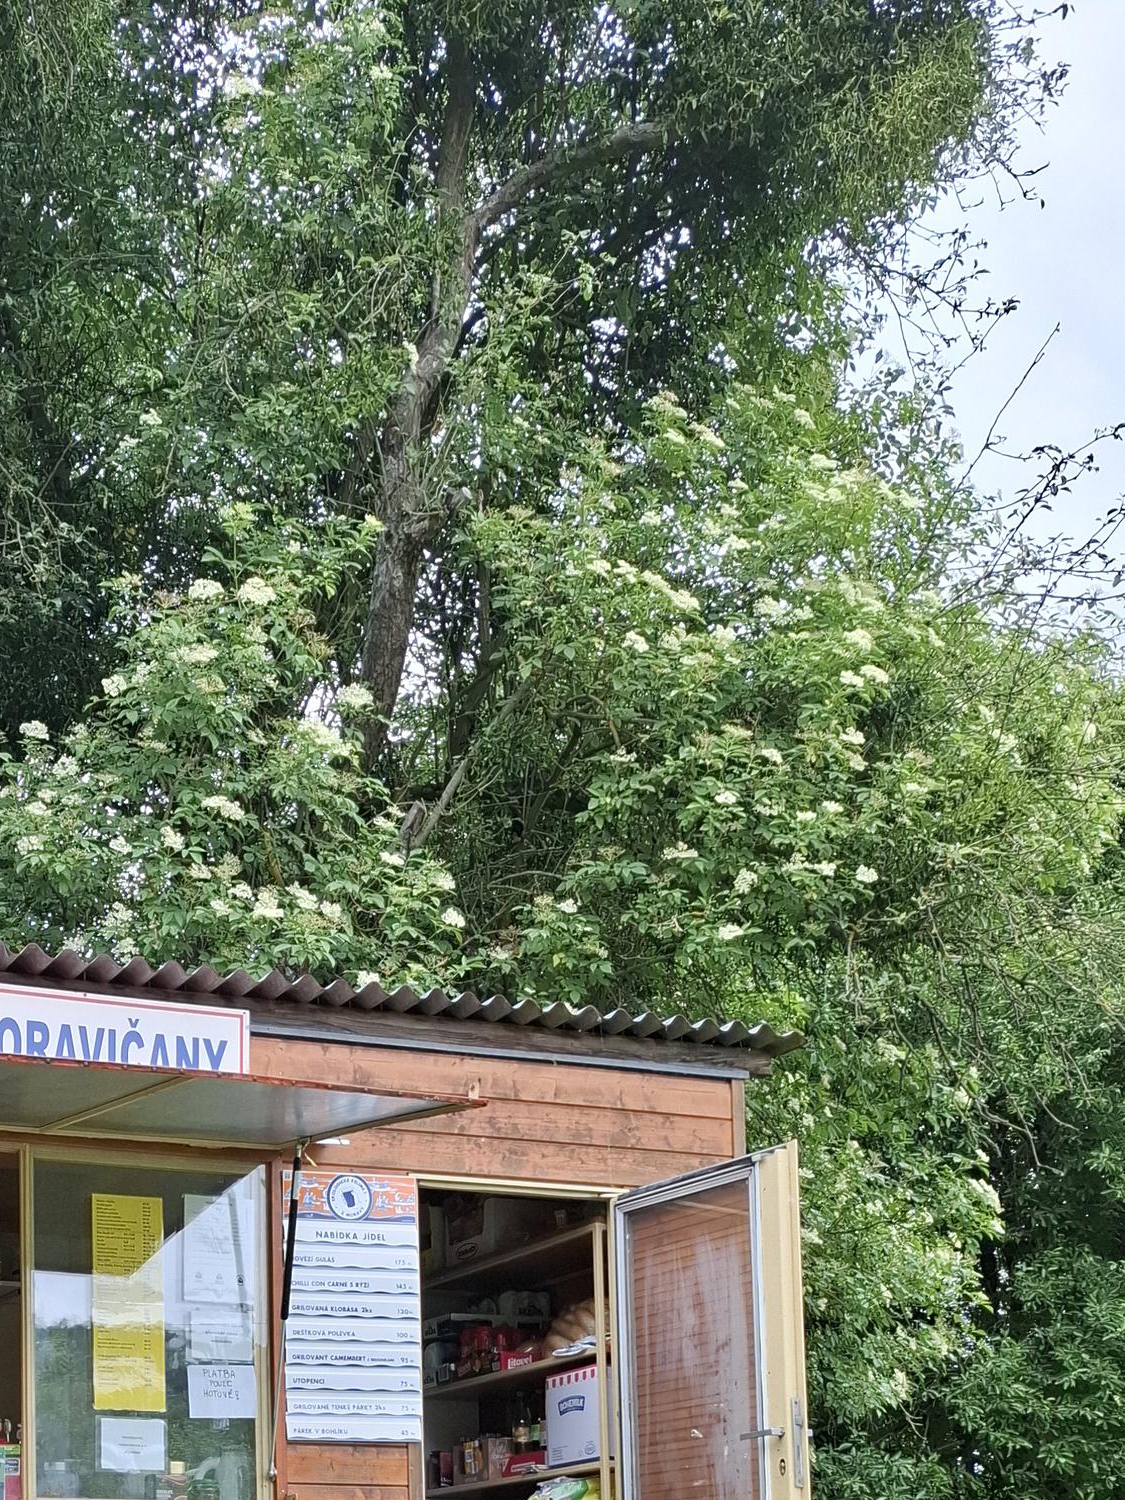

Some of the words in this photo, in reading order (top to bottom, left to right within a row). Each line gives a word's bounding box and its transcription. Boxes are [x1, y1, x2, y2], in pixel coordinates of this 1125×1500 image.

[315, 1229, 358, 1240] NABÍDKA
[363, 1231, 387, 1241] JÍDEL
[203, 1368, 236, 1379] PLATBA
[292, 1377, 325, 1385] UTOPENCI
